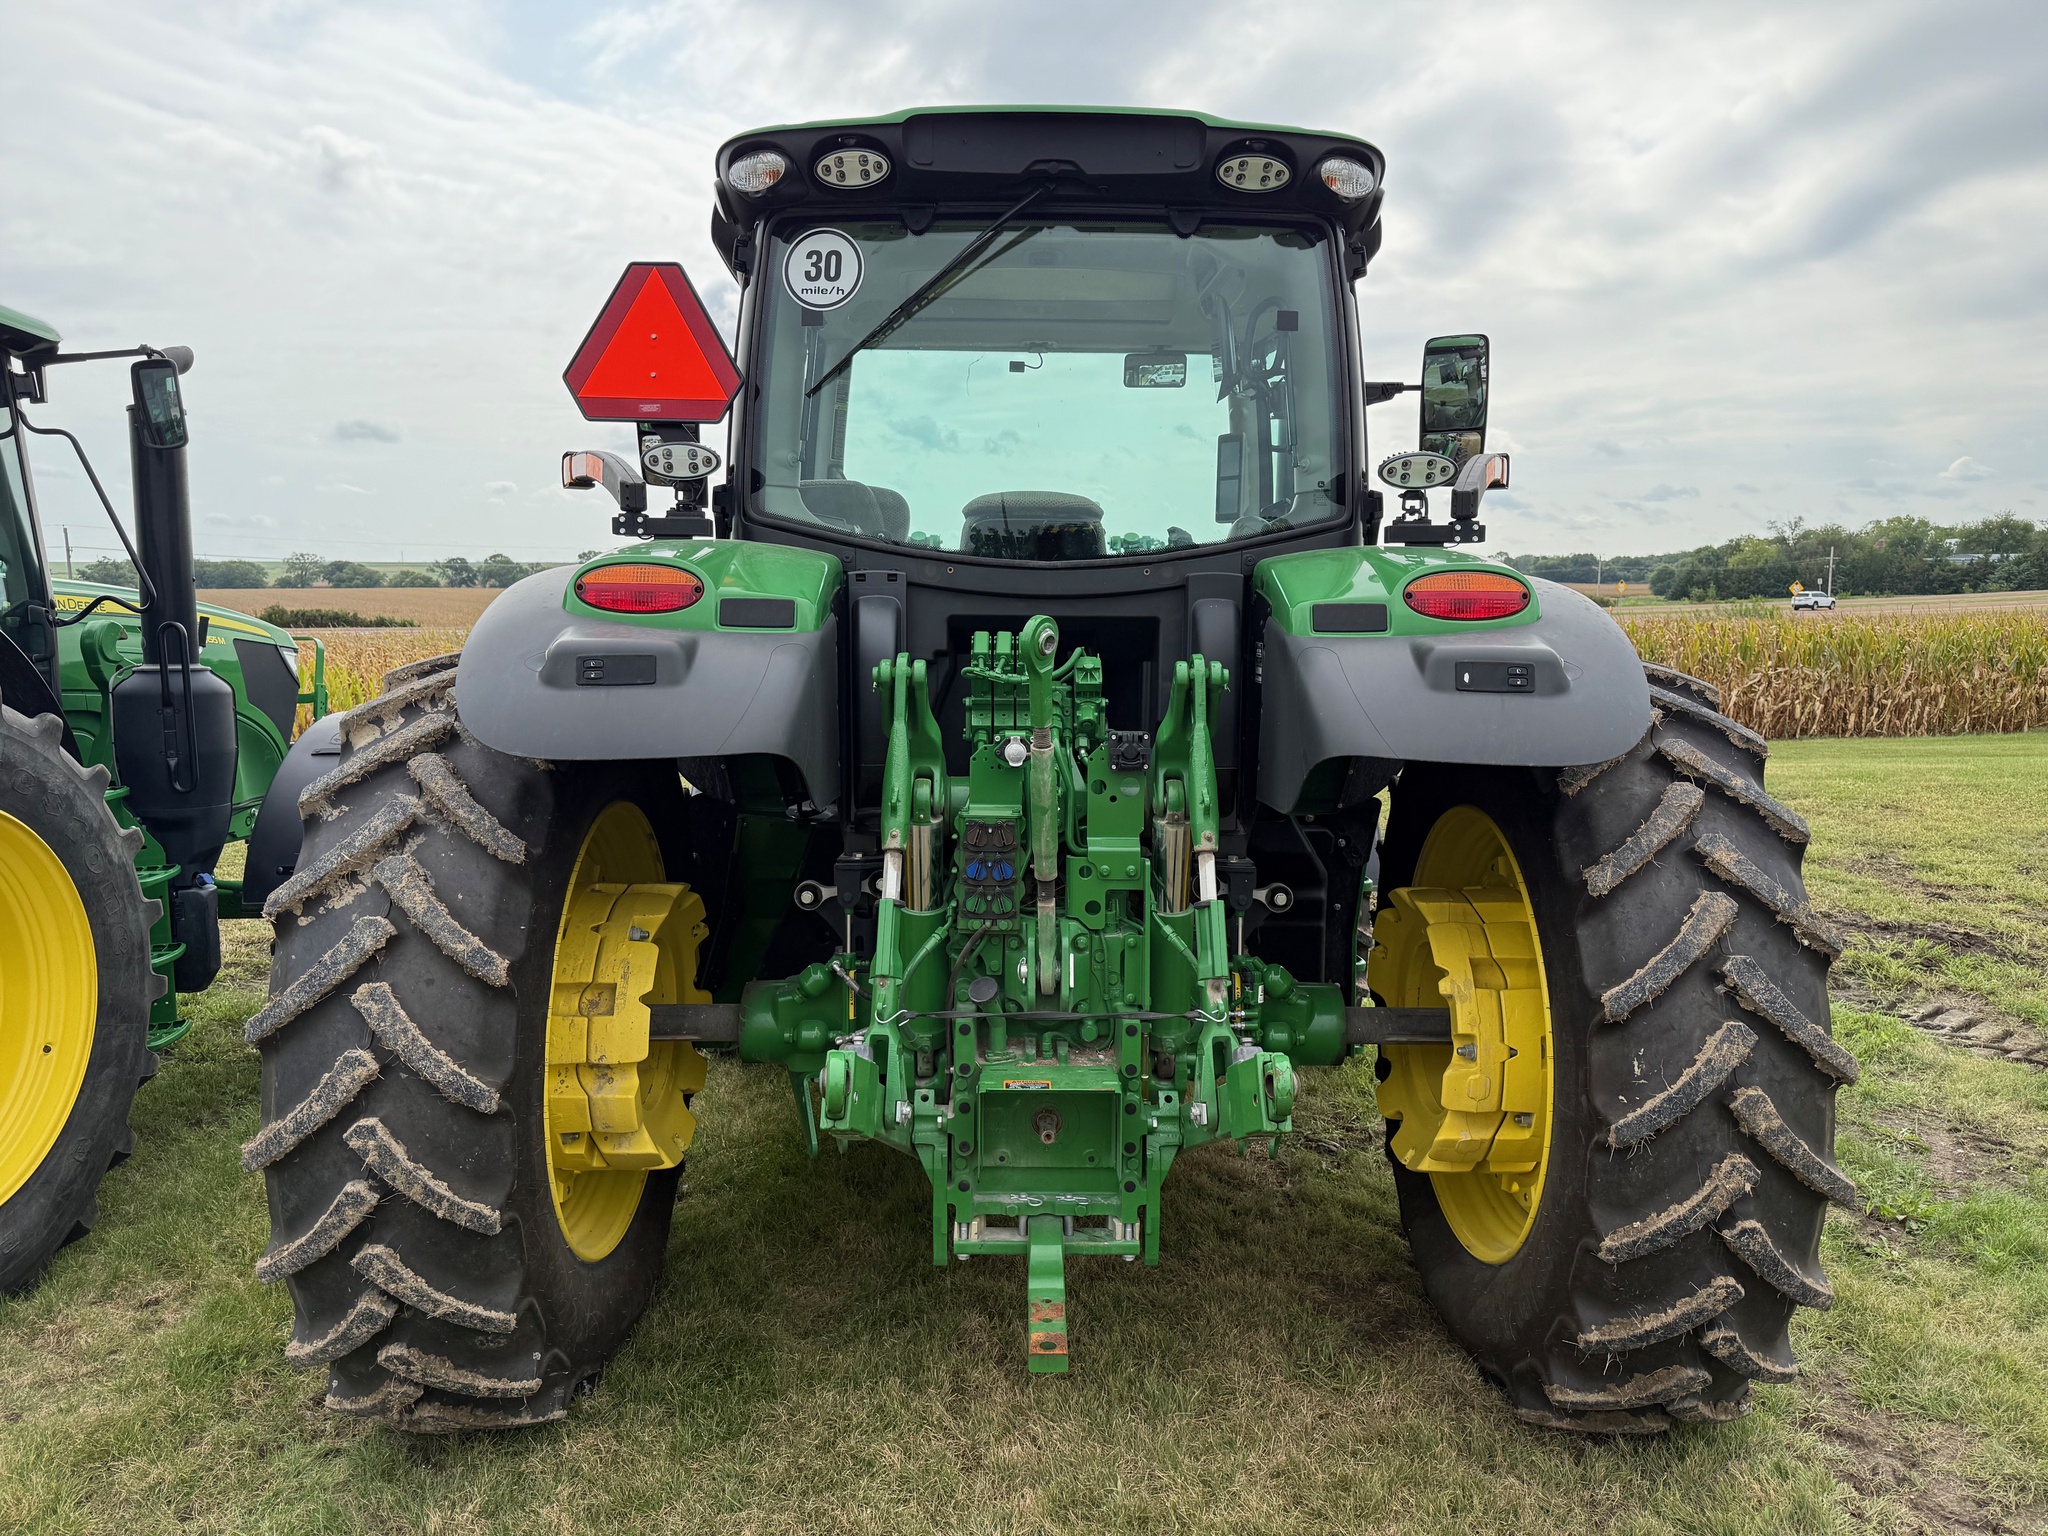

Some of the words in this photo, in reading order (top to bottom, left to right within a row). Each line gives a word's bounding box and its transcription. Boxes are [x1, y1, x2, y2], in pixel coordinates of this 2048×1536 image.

[804, 249, 843, 282] 30
[801, 286, 845, 295] mile/h
[67, 598, 106, 612] DEEE
